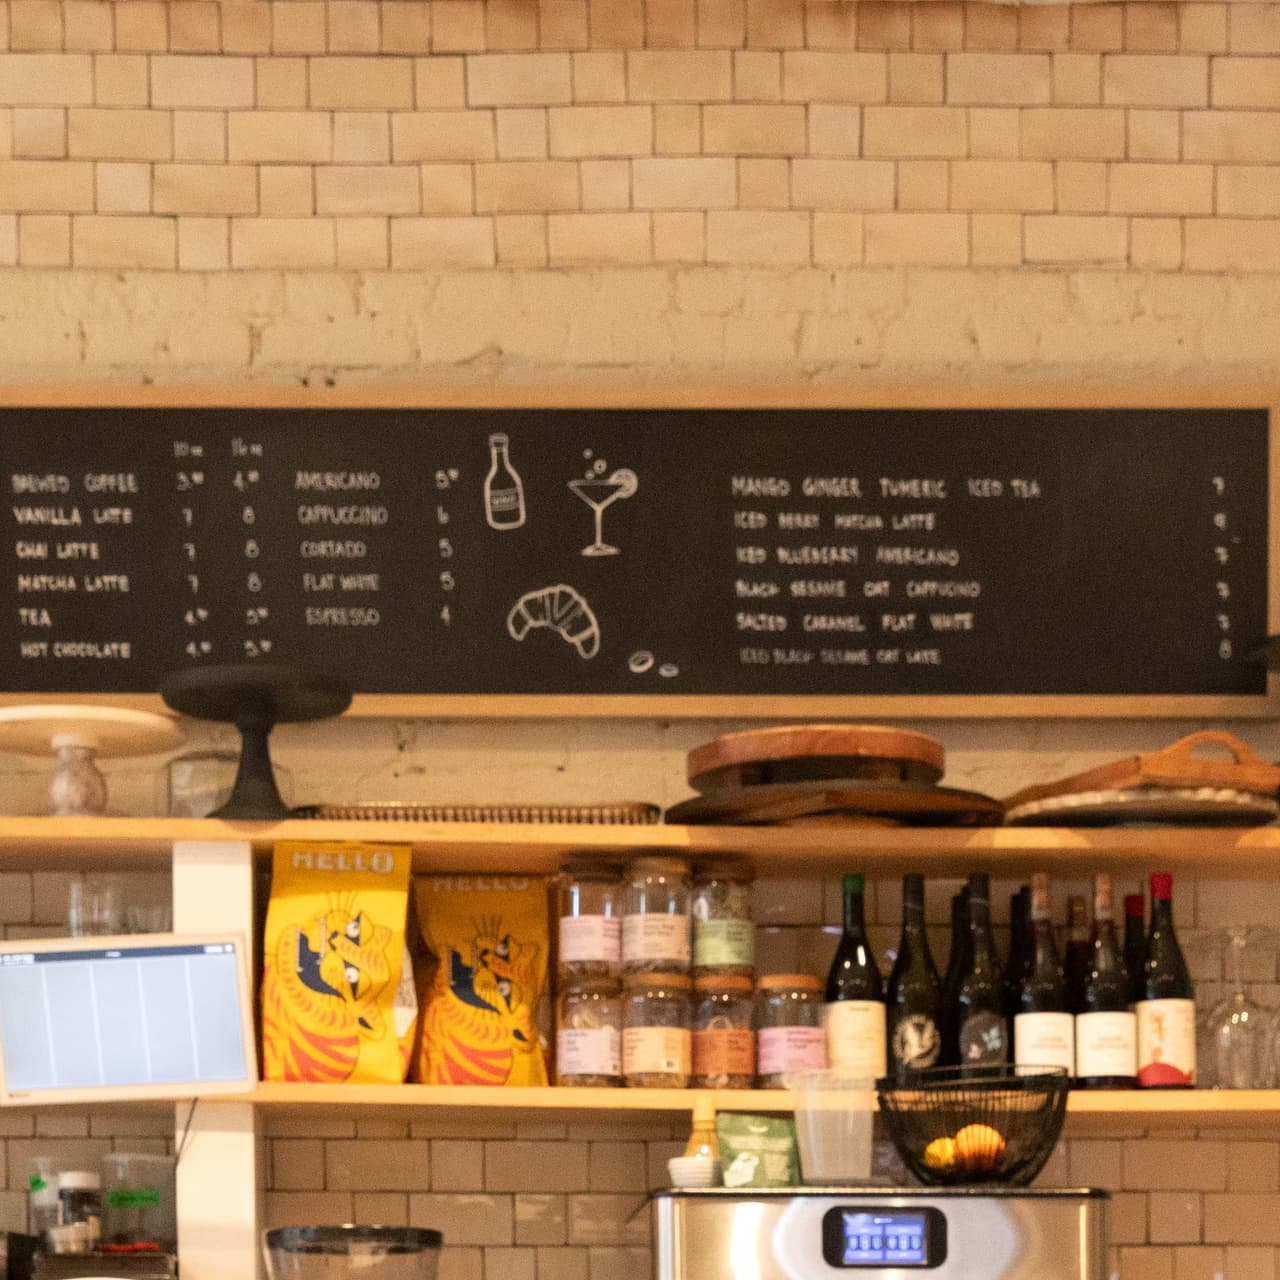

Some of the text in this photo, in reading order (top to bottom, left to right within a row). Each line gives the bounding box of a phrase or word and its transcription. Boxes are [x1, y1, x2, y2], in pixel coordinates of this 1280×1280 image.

[84, 473, 140, 494] COFFEE
[295, 470, 381, 491] AMERICANO
[731, 476, 791, 498] MANGO
[802, 476, 863, 498] GINGER
[968, 479, 1004, 498] ICED
[1010, 479, 1041, 499] TEA
[13, 506, 82, 527] VANILLA
[93, 507, 133, 526] LATTE
[298, 505, 389, 526] CAPPUCCINO
[734, 511, 768, 529] ICED
[892, 511, 936, 531] LATTE
[16, 541, 48, 560] CHAI
[56, 542, 100, 560] LATTE
[245, 540, 260, 559] 8
[300, 538, 454, 558] CORTADO 5
[735, 546, 768, 564] ICED
[777, 546, 859, 565] BLUEBERRY
[876, 545, 960, 567] AMERICANO
[18, 574, 77, 592] MATCHA
[84, 574, 130, 592] LATTE
[247, 572, 262, 593] 8
[303, 571, 455, 592] FLAT WHITE 5
[19, 608, 53, 626] TEA
[305, 606, 380, 626] ESPRESSO
[736, 612, 787, 631] SALTED
[803, 613, 866, 632] CARAMEL
[881, 613, 917, 632] FLAT
[929, 612, 975, 631] WHITE
[20, 641, 48, 658] HOT
[53, 641, 131, 659] CHOCOLATE
